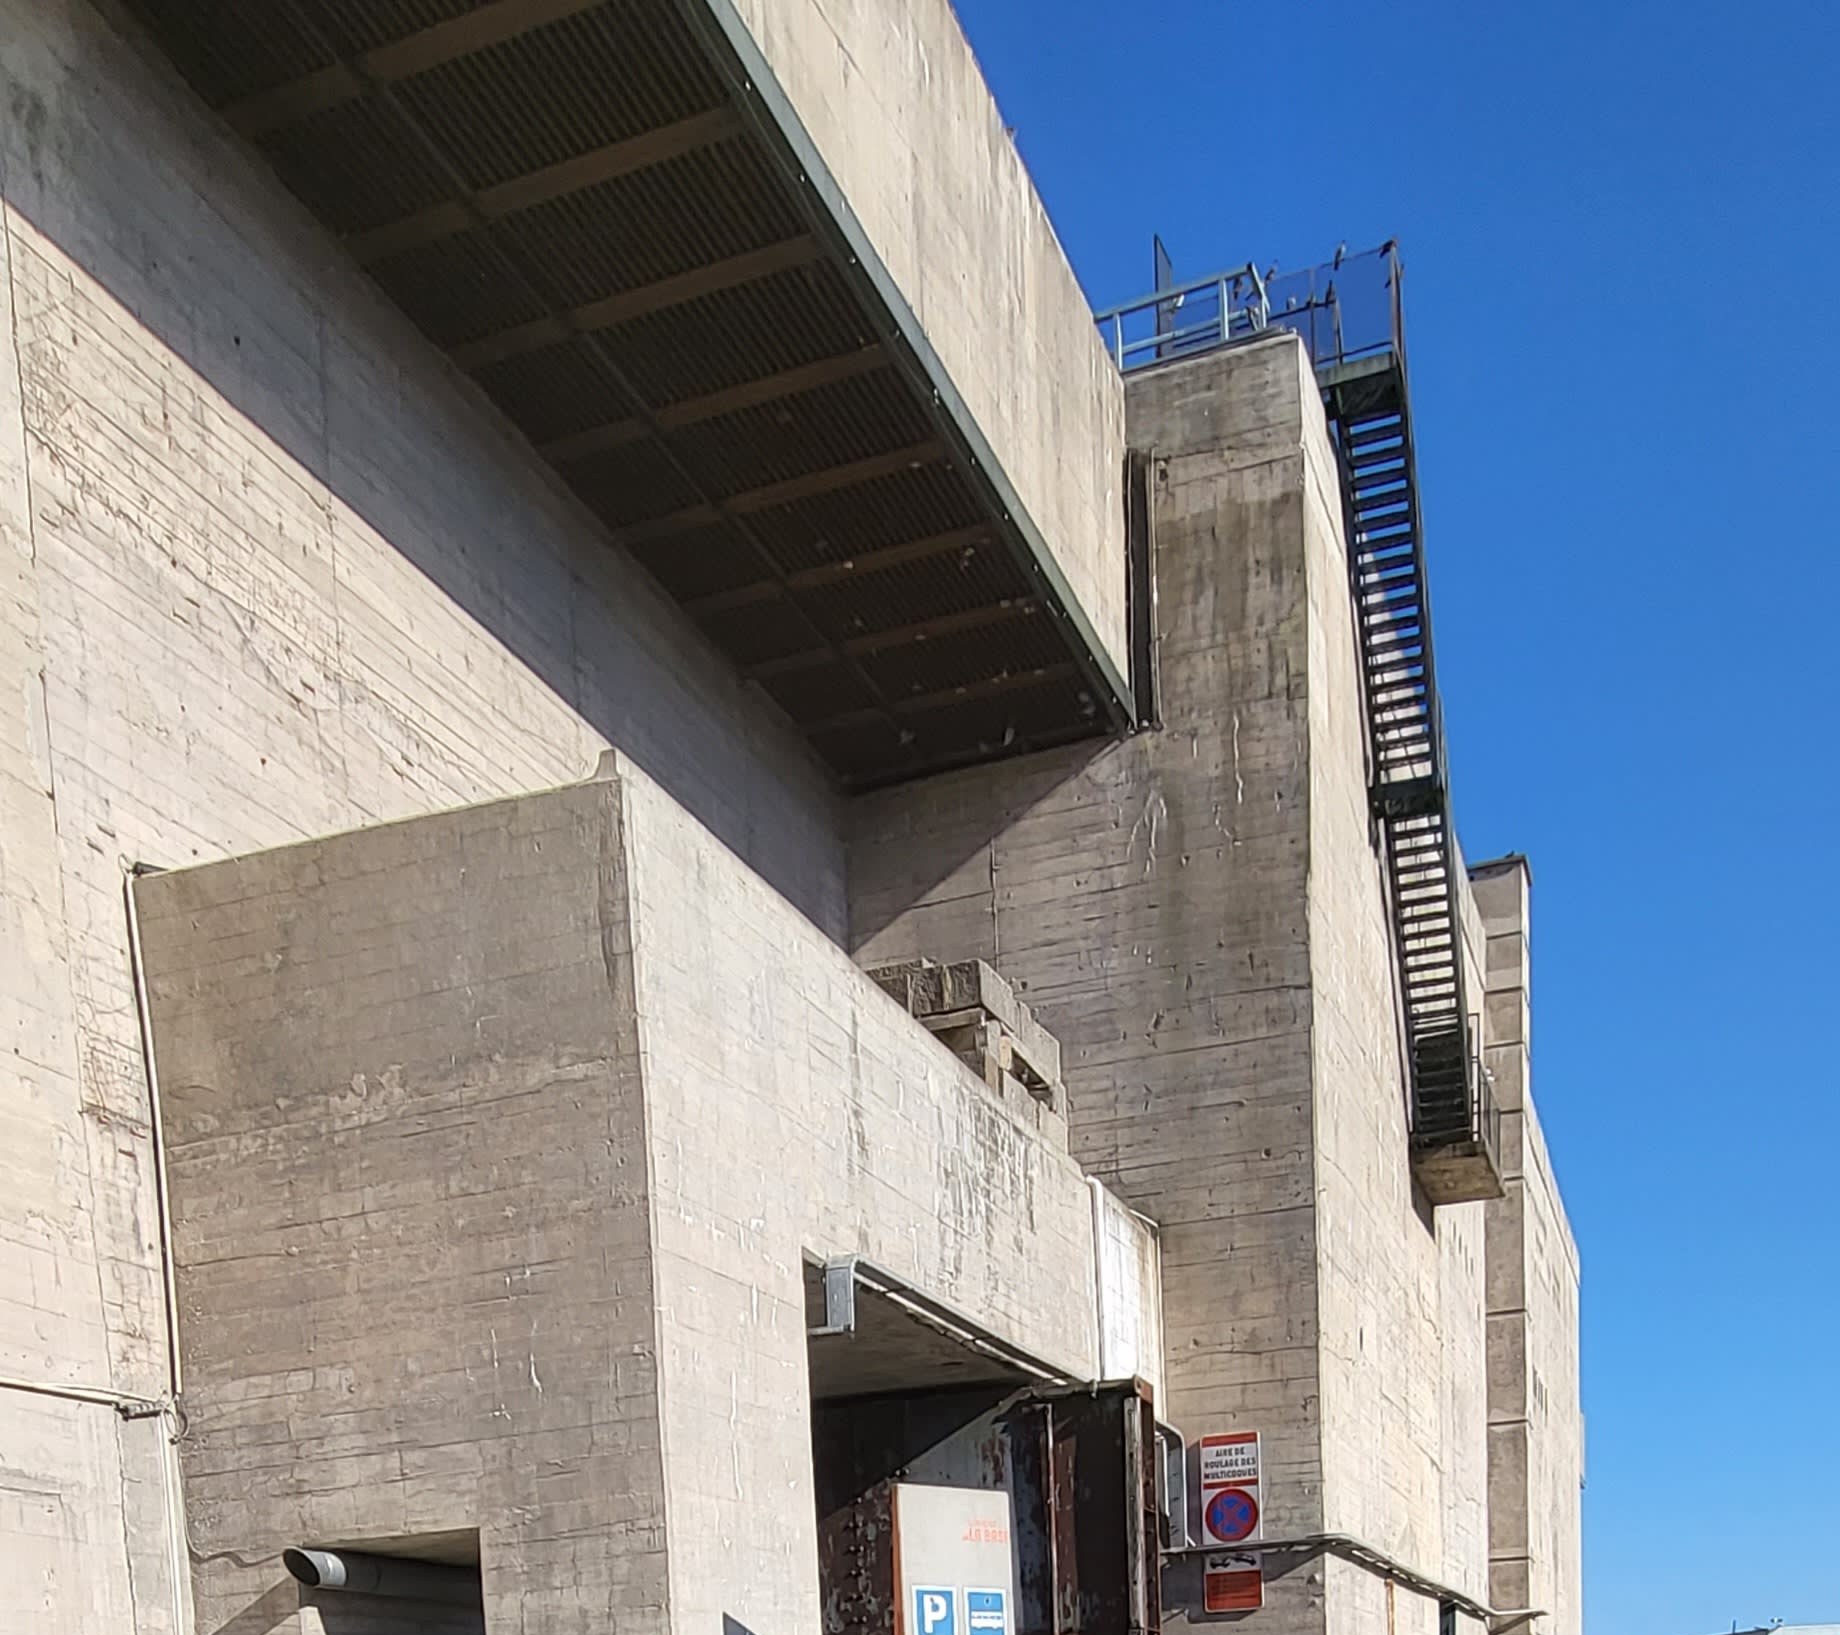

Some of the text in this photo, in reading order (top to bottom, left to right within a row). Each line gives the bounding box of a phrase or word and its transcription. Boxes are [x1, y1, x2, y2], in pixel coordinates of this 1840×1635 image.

[1215, 1447, 1245, 1457] AIRE DE
[1204, 1457, 1256, 1469] ROULAGE DES
[1203, 1468, 1257, 1479] MULTICOQUES
[922, 1594, 947, 1635] P
